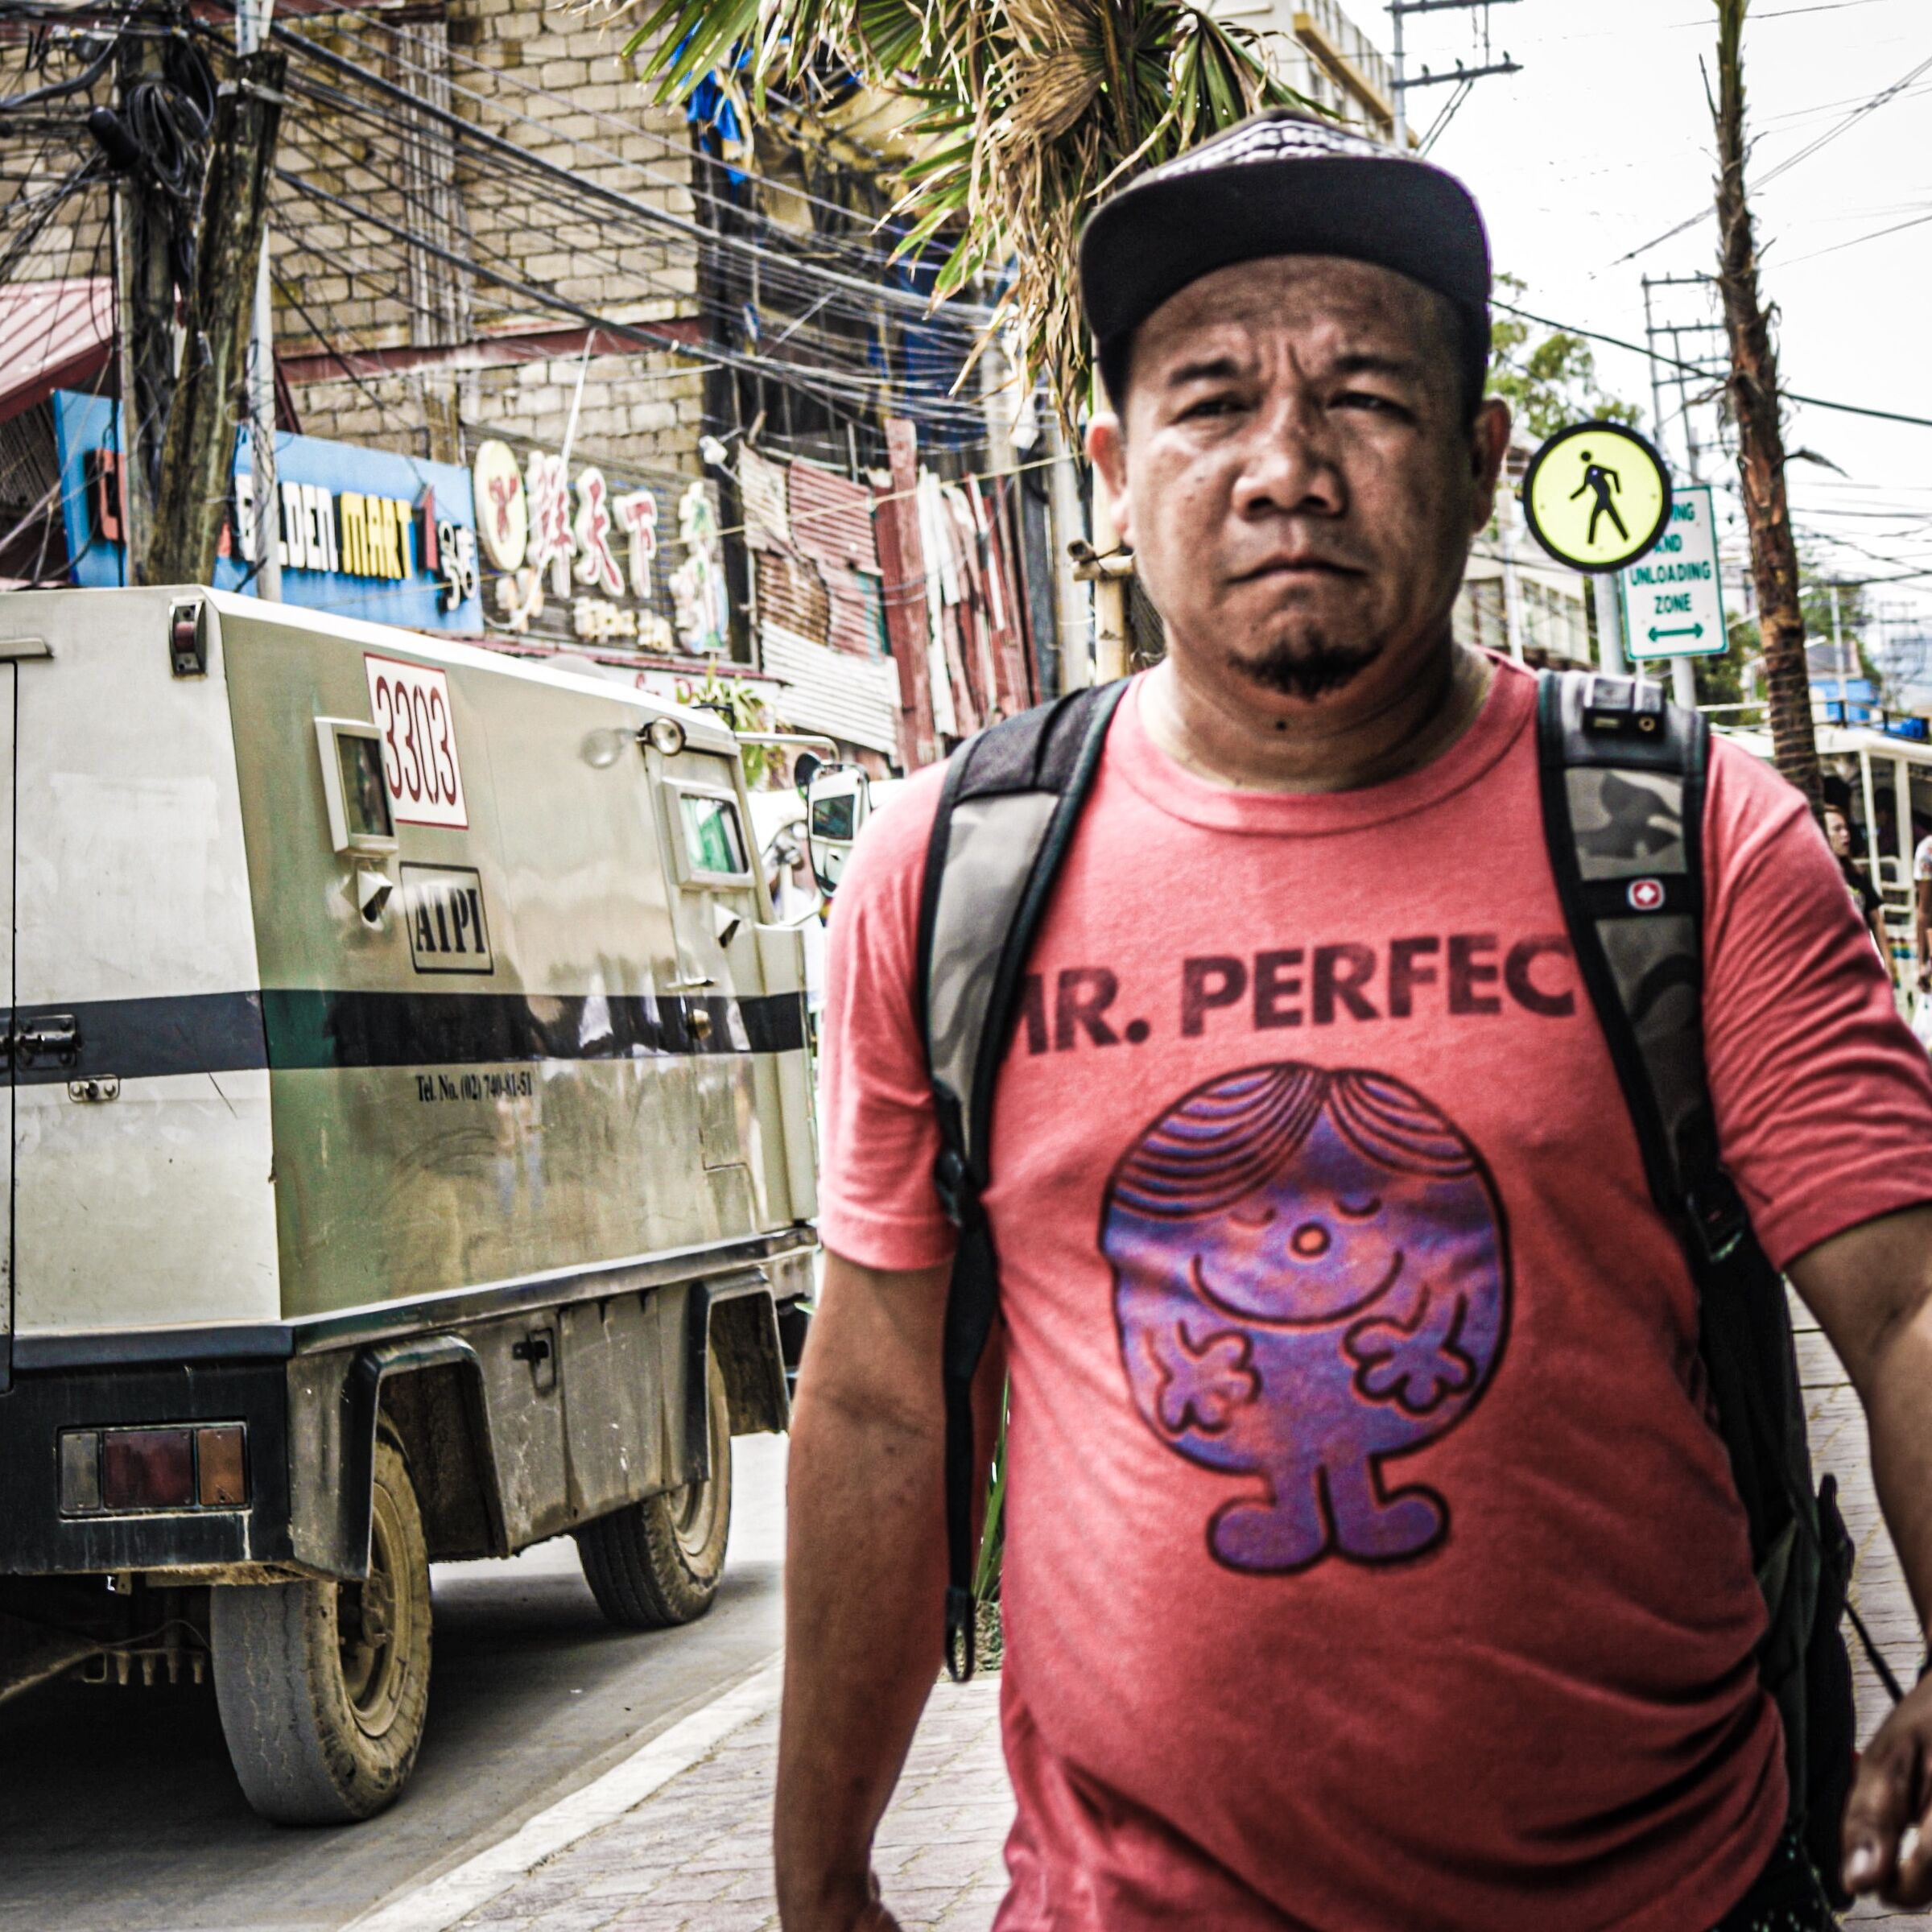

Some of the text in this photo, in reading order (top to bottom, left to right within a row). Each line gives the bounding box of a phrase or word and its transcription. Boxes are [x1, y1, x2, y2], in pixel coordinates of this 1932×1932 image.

[340, 491, 413, 580] MART
[1629, 560, 1711, 586] UNLOADING
[1653, 592, 1692, 615] ZONE
[376, 675, 456, 806] 3303
[415, 1073, 437, 1102] Tel.
[438, 1073, 460, 1101] No.
